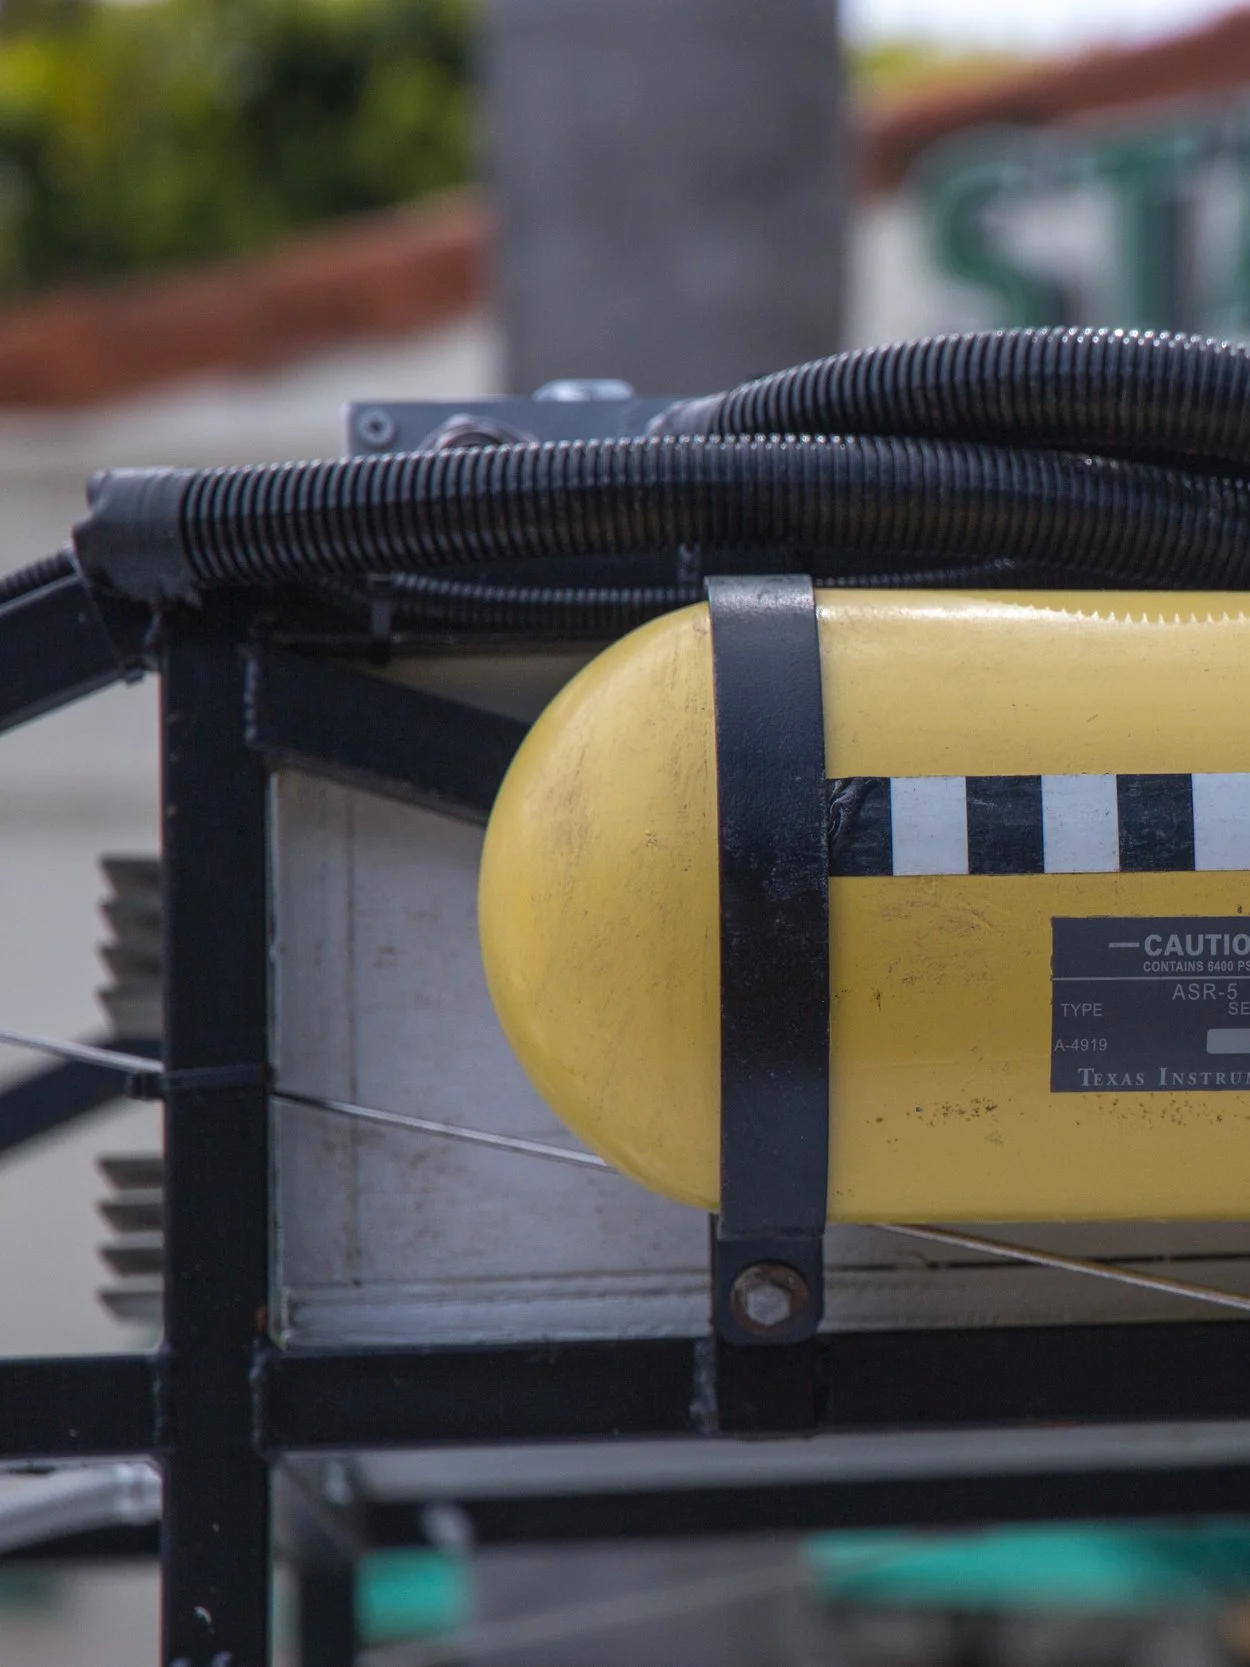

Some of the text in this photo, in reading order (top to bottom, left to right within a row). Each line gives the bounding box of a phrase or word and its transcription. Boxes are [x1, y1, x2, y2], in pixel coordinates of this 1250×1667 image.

[1143, 960, 1204, 973] CONTAINS
[1207, 960, 1234, 972] 6400
[1172, 983, 1238, 1001] ASR-5
[1061, 1003, 1103, 1017] TYPE
[1054, 1038, 1108, 1052] A-4919
[1078, 1067, 1145, 1087] TEXAS
